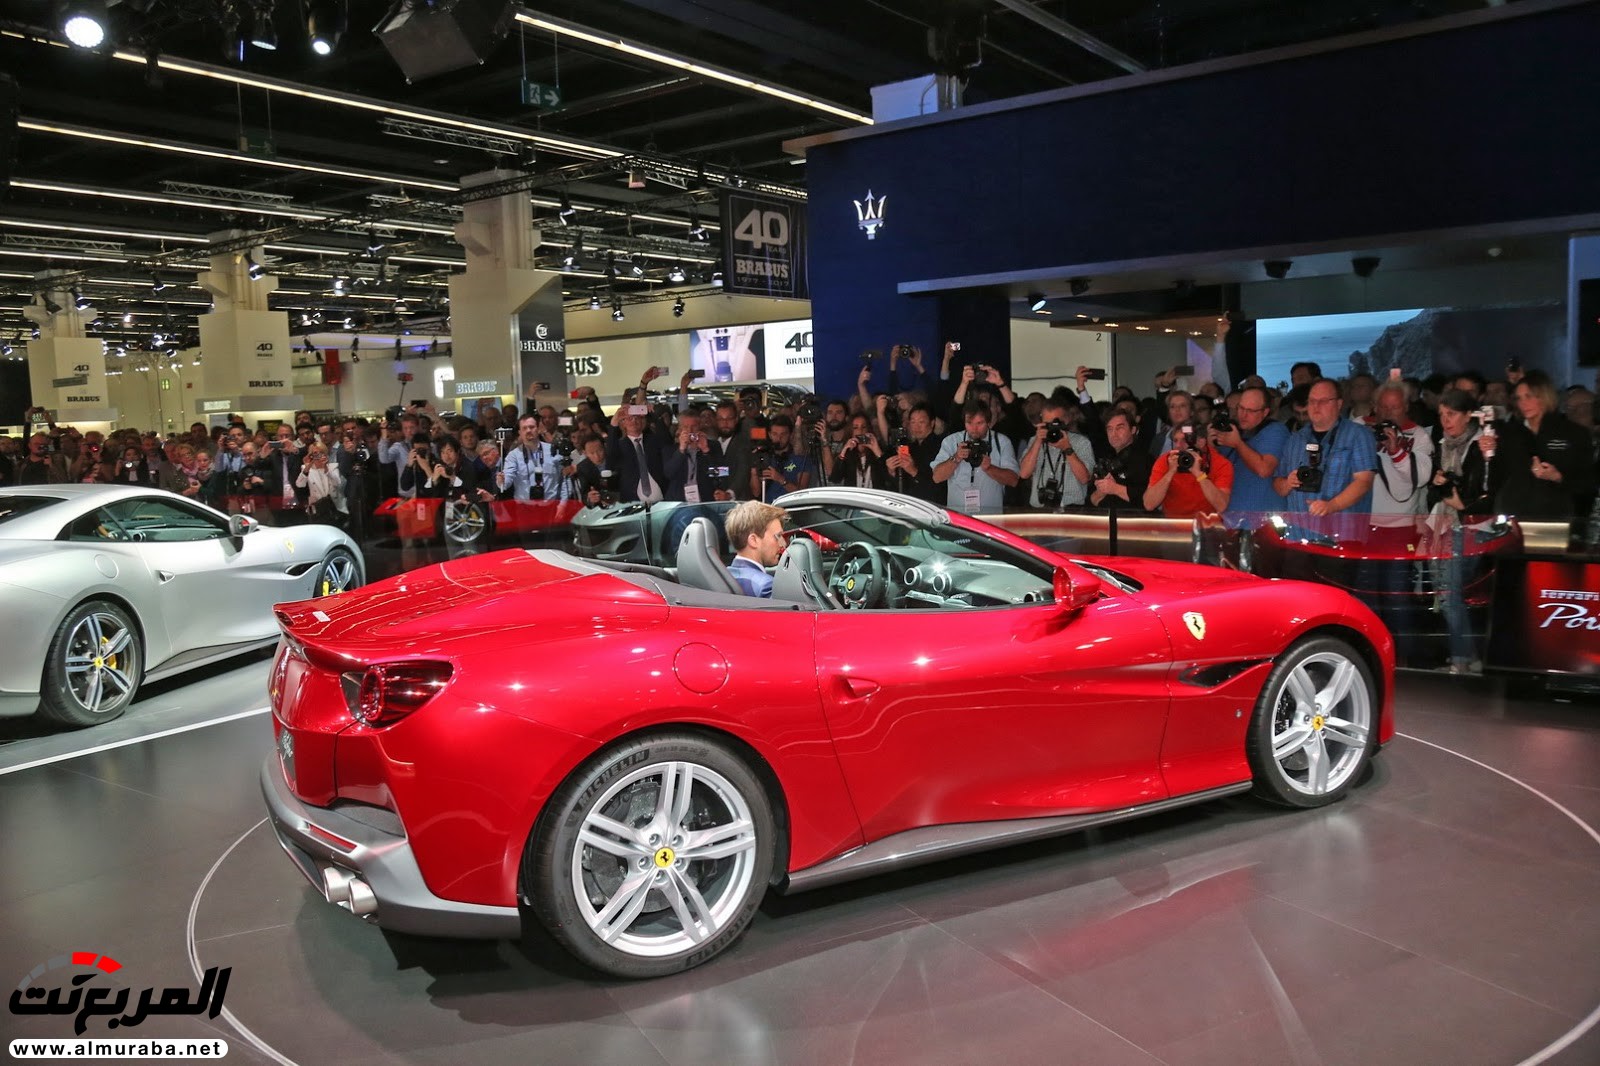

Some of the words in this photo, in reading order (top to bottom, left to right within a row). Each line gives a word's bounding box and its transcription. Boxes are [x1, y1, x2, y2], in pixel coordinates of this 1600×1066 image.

[734, 209, 788, 249] 40
[736, 260, 789, 278] BRABUS
[785, 331, 813, 352] 40
[1096, 333, 1101, 341] 2
[256, 343, 273, 351] 40
[520, 340, 565, 352] BRABUS
[565, 356, 601, 376] BUS
[456, 381, 497, 394] BRABUS
[1540, 590, 1600, 601] Ferrari
[578, 751, 646, 808] MICHELIN
